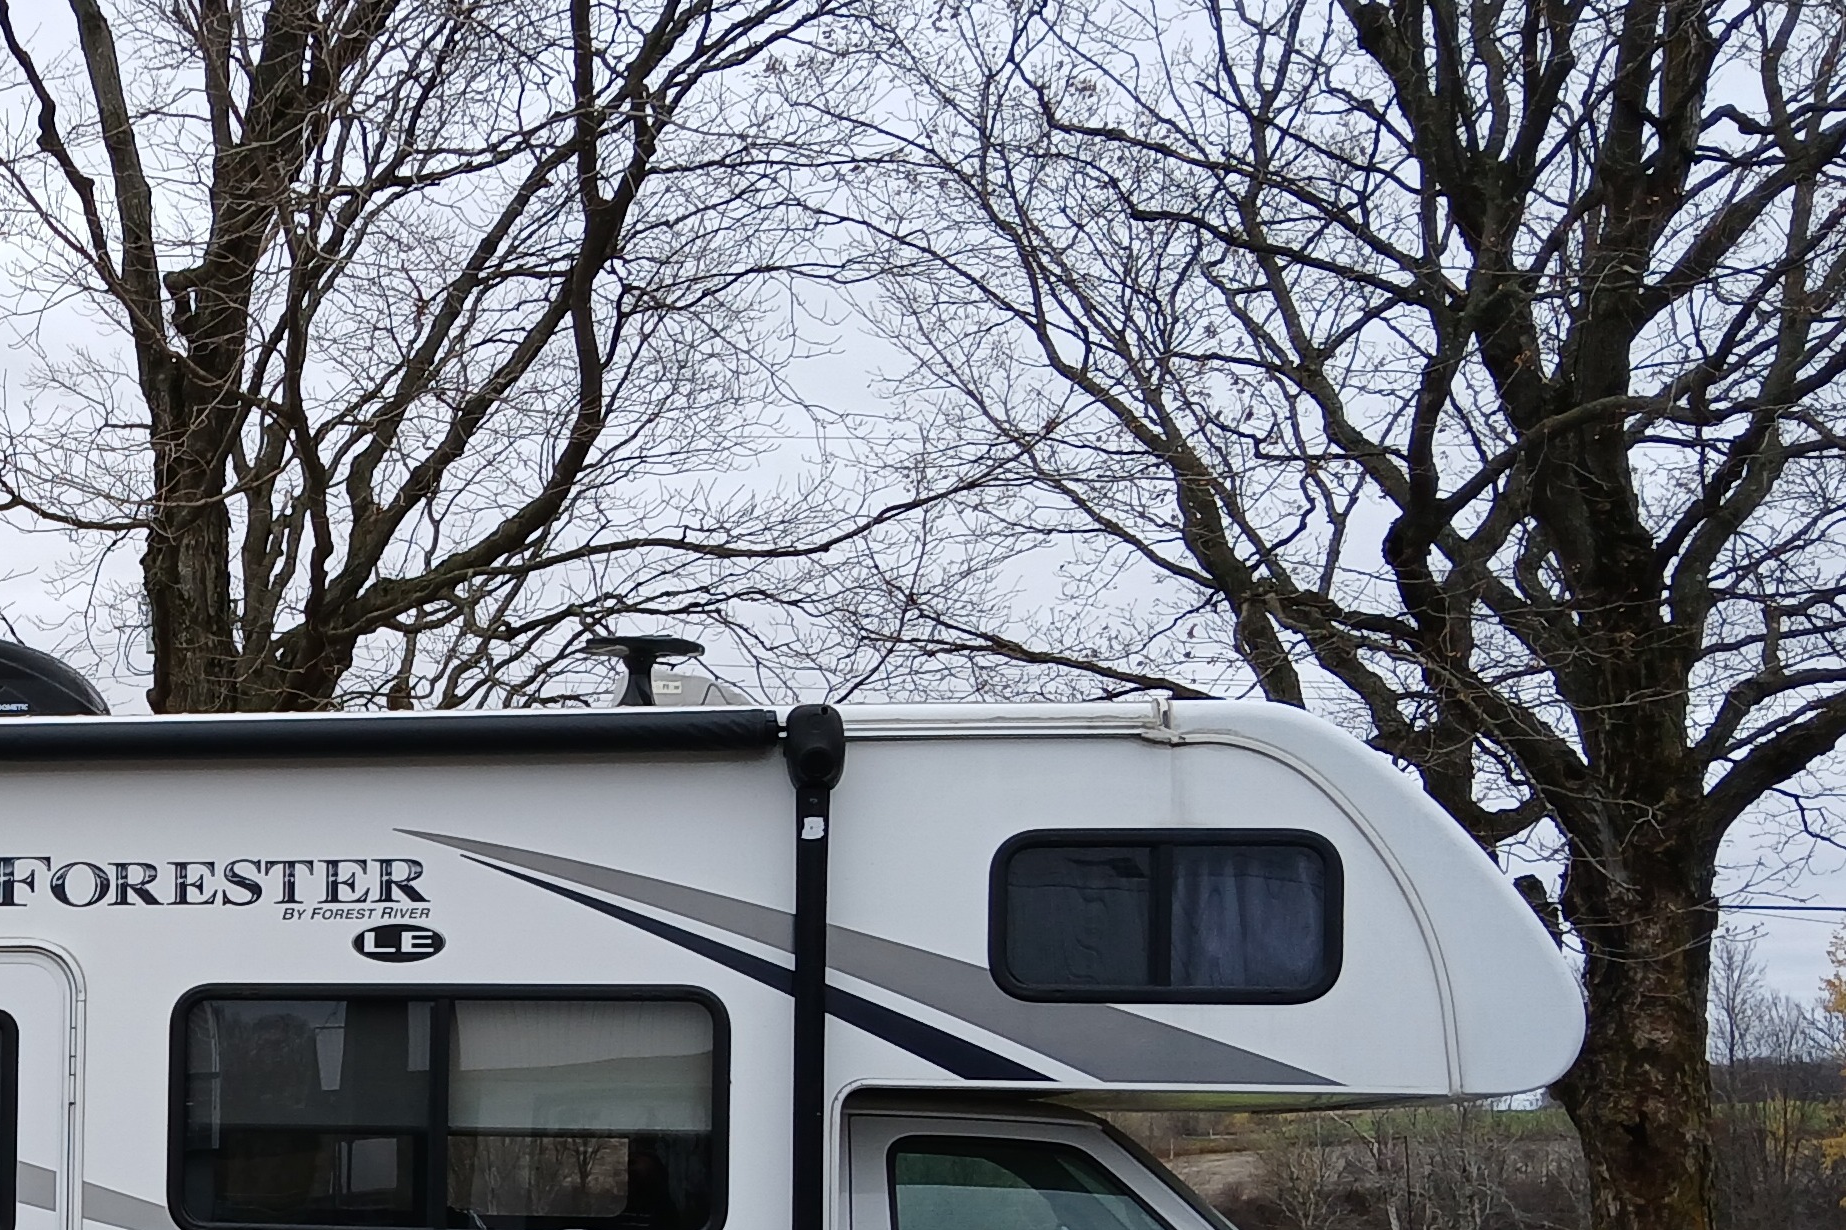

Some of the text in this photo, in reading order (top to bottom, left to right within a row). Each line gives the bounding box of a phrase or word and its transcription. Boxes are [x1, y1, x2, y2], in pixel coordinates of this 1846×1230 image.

[282, 906, 431, 920] BY FOREST RIVER
[363, 931, 434, 952] LE
